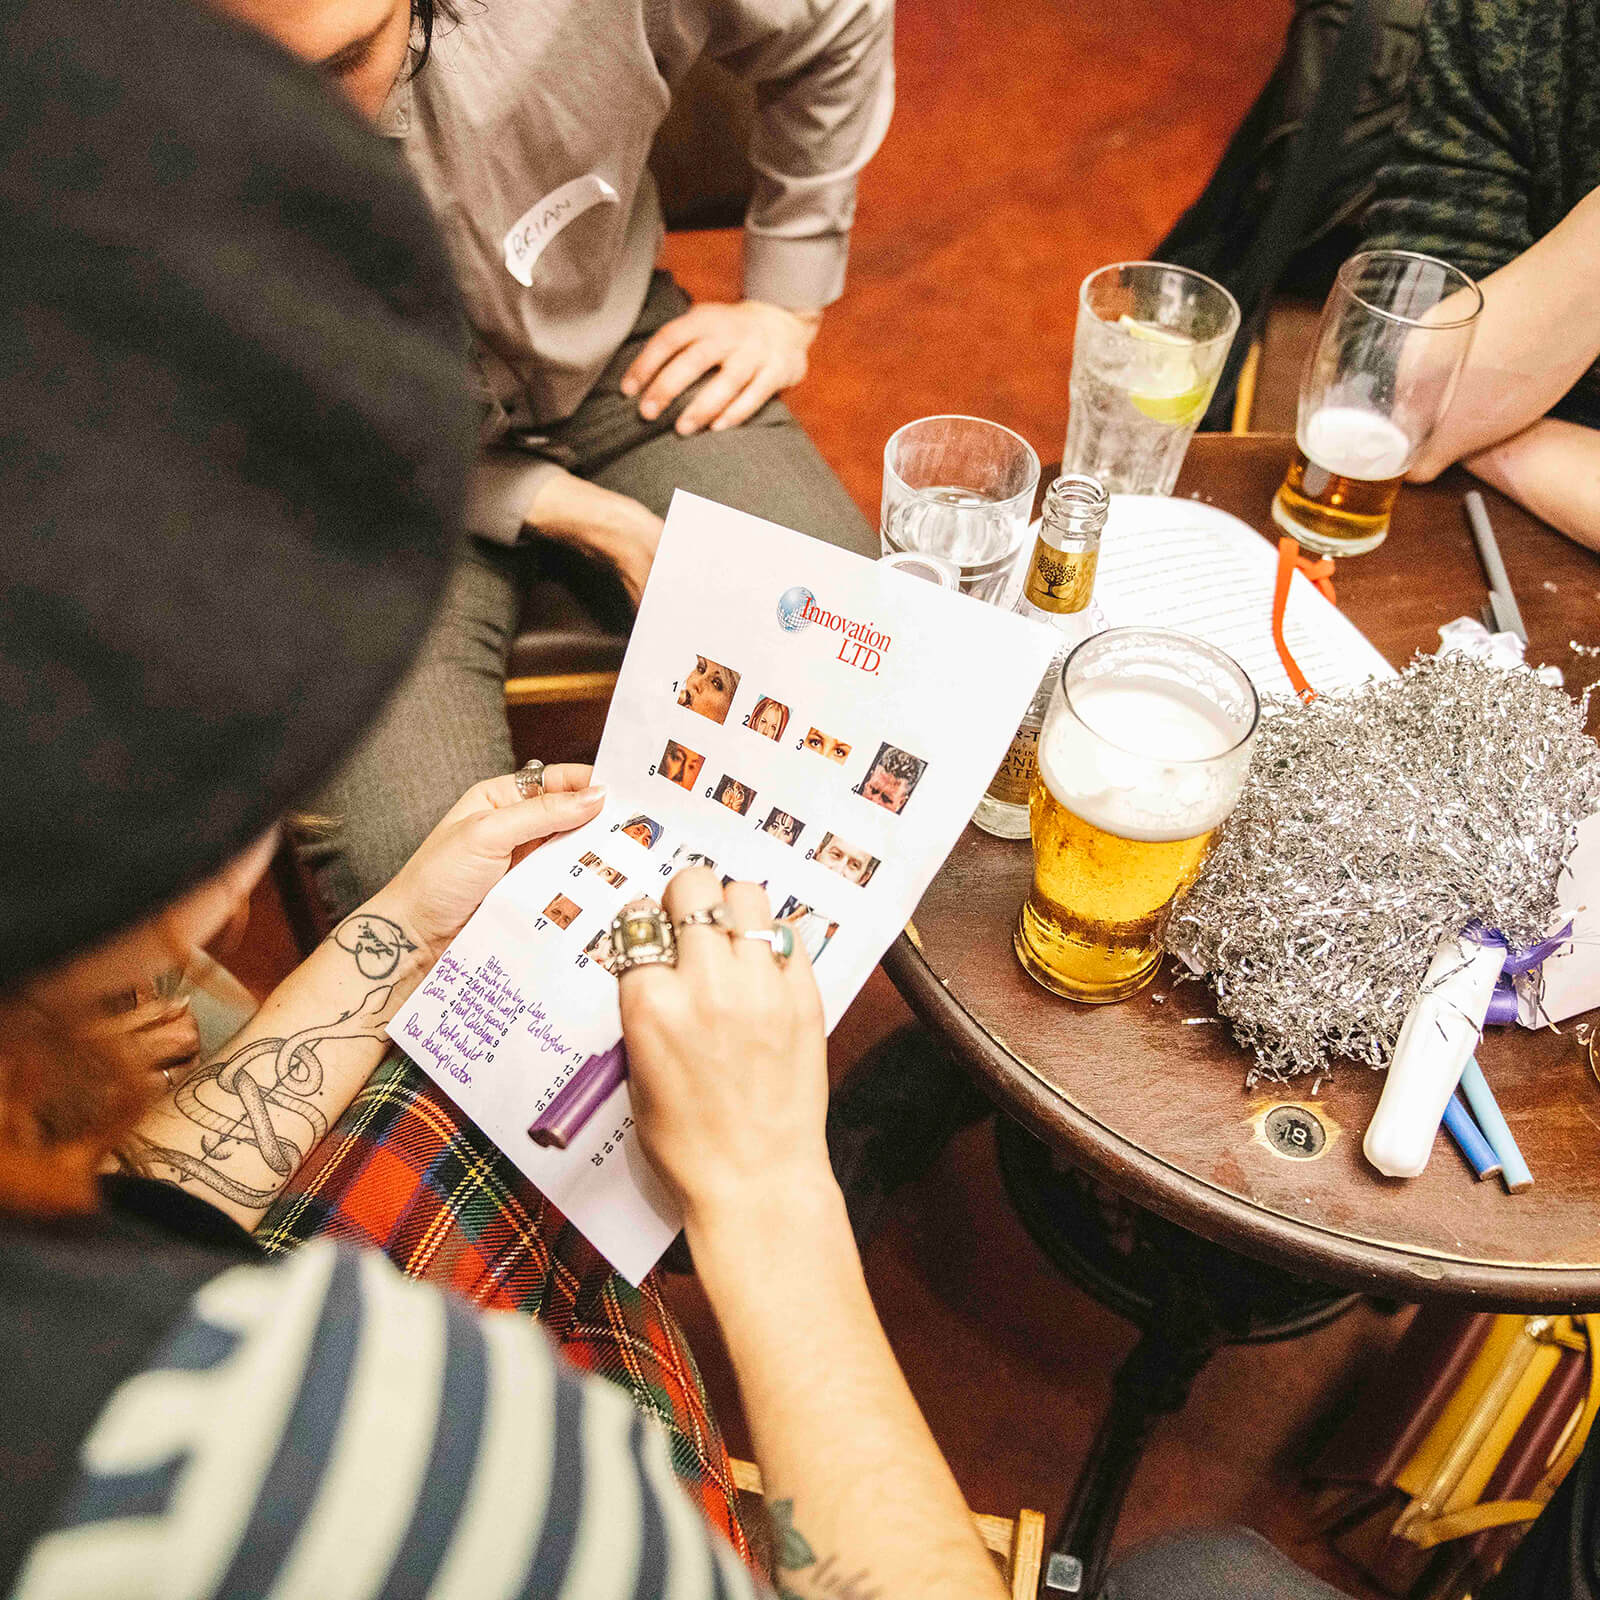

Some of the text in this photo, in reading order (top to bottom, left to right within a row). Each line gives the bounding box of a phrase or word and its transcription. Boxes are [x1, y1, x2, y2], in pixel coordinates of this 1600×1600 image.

[513, 199, 571, 260] BRIAN
[800, 596, 892, 653] Innovation
[836, 638, 881, 676] LTD.
[672, 681, 679, 692] 1
[742, 714, 751, 726] 2
[796, 738, 804, 750] 3
[648, 765, 656, 776] 5
[1000, 765, 1033, 779] ATE
[704, 787, 713, 798] 6
[610, 823, 620, 833] 9
[754, 819, 764, 830] 7
[805, 848, 814, 860] 8
[569, 864, 583, 878] 13
[658, 863, 672, 876] 10
[533, 917, 548, 931] 17
[574, 954, 589, 969] 18
[465, 977, 473, 986] 2
[457, 988, 465, 997] 3
[449, 999, 456, 1008] 4
[518, 1005, 526, 1014] 6
[440, 1010, 448, 1019] 5
[501, 1027, 509, 1037] 8
[492, 1039, 500, 1048] 9
[484, 1052, 495, 1063] 10
[572, 1053, 583, 1064] 11
[563, 1064, 574, 1077] 12
[553, 1076, 565, 1088] 13
[543, 1088, 555, 1099] 14
[534, 1100, 546, 1112] 15
[622, 1117, 635, 1129] 17
[612, 1129, 624, 1142] 18
[602, 1141, 614, 1154] 19
[591, 1153, 604, 1166] 20
